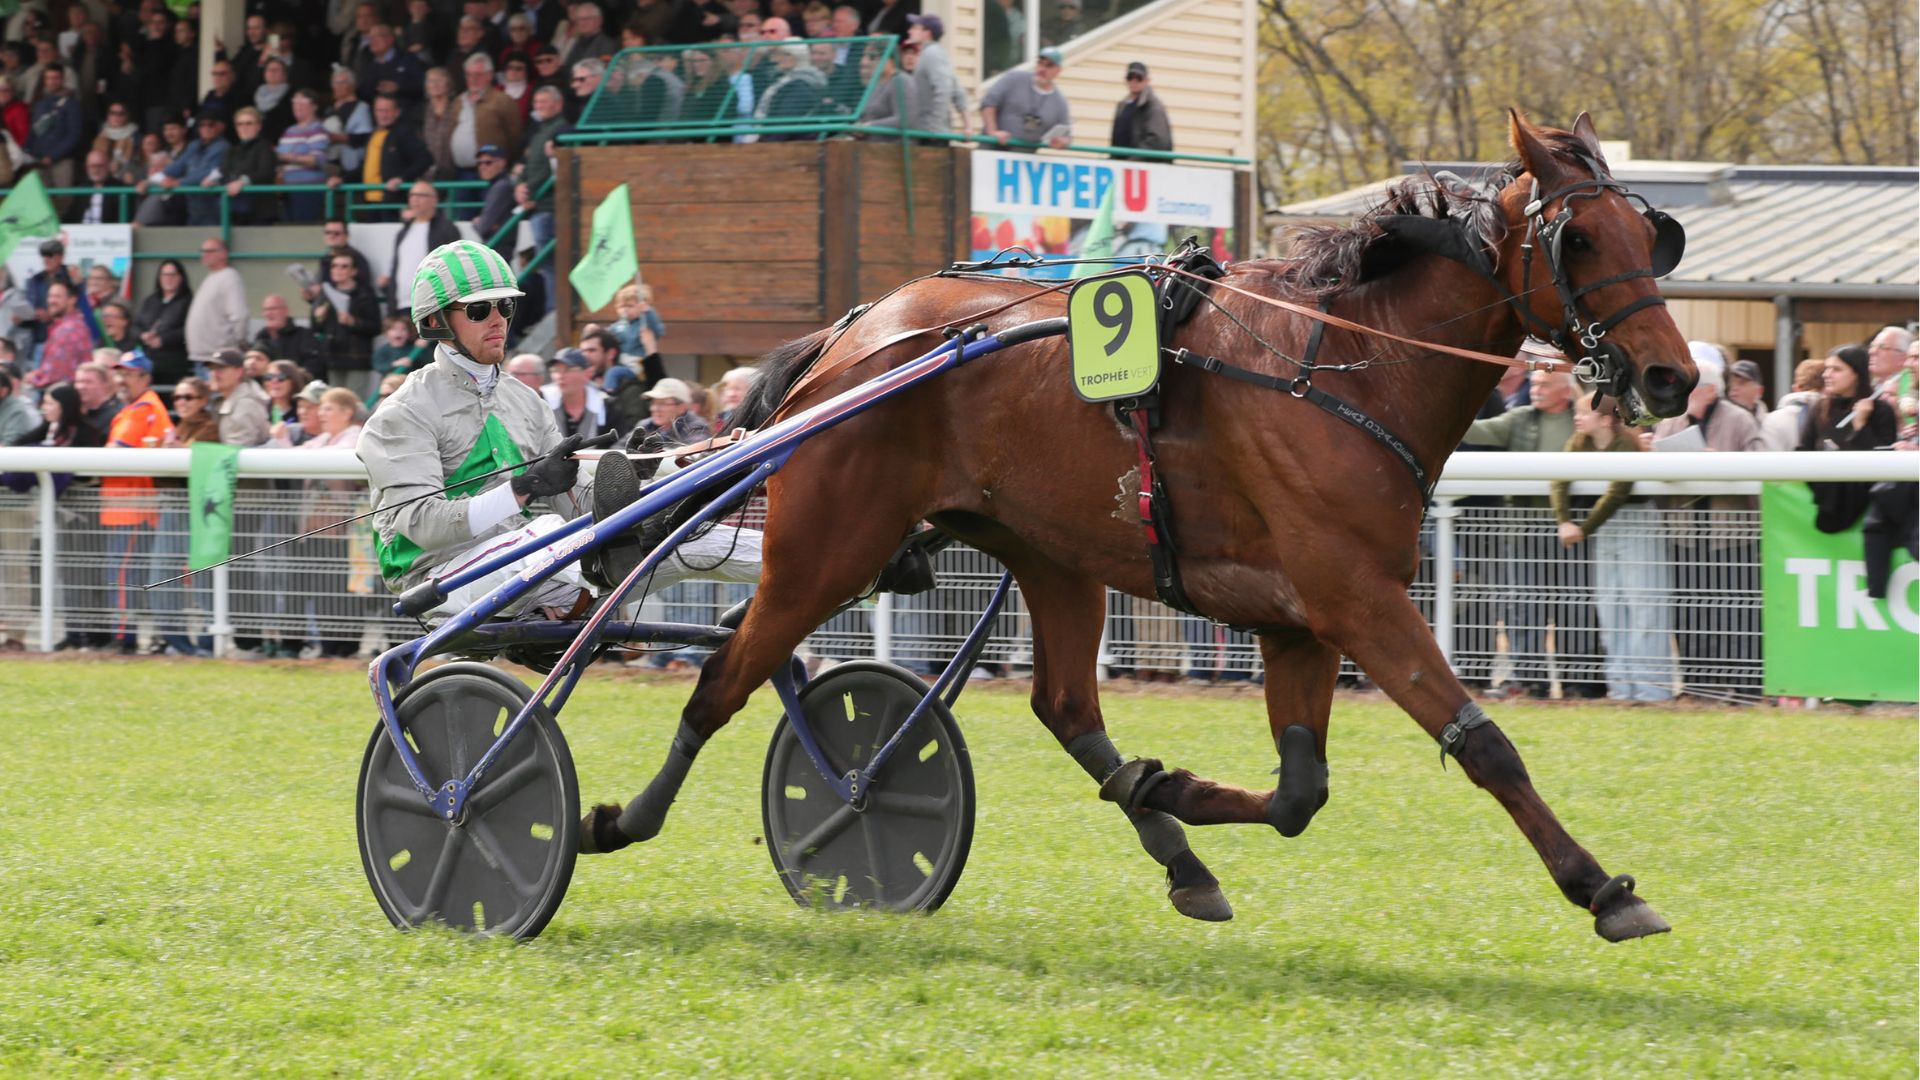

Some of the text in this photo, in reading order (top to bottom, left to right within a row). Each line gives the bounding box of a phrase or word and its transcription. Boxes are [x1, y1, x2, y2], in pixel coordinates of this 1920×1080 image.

[1122, 167, 1149, 213] U
[1093, 280, 1133, 357] 9
[1081, 365, 1154, 386] TROPHÉE VERT
